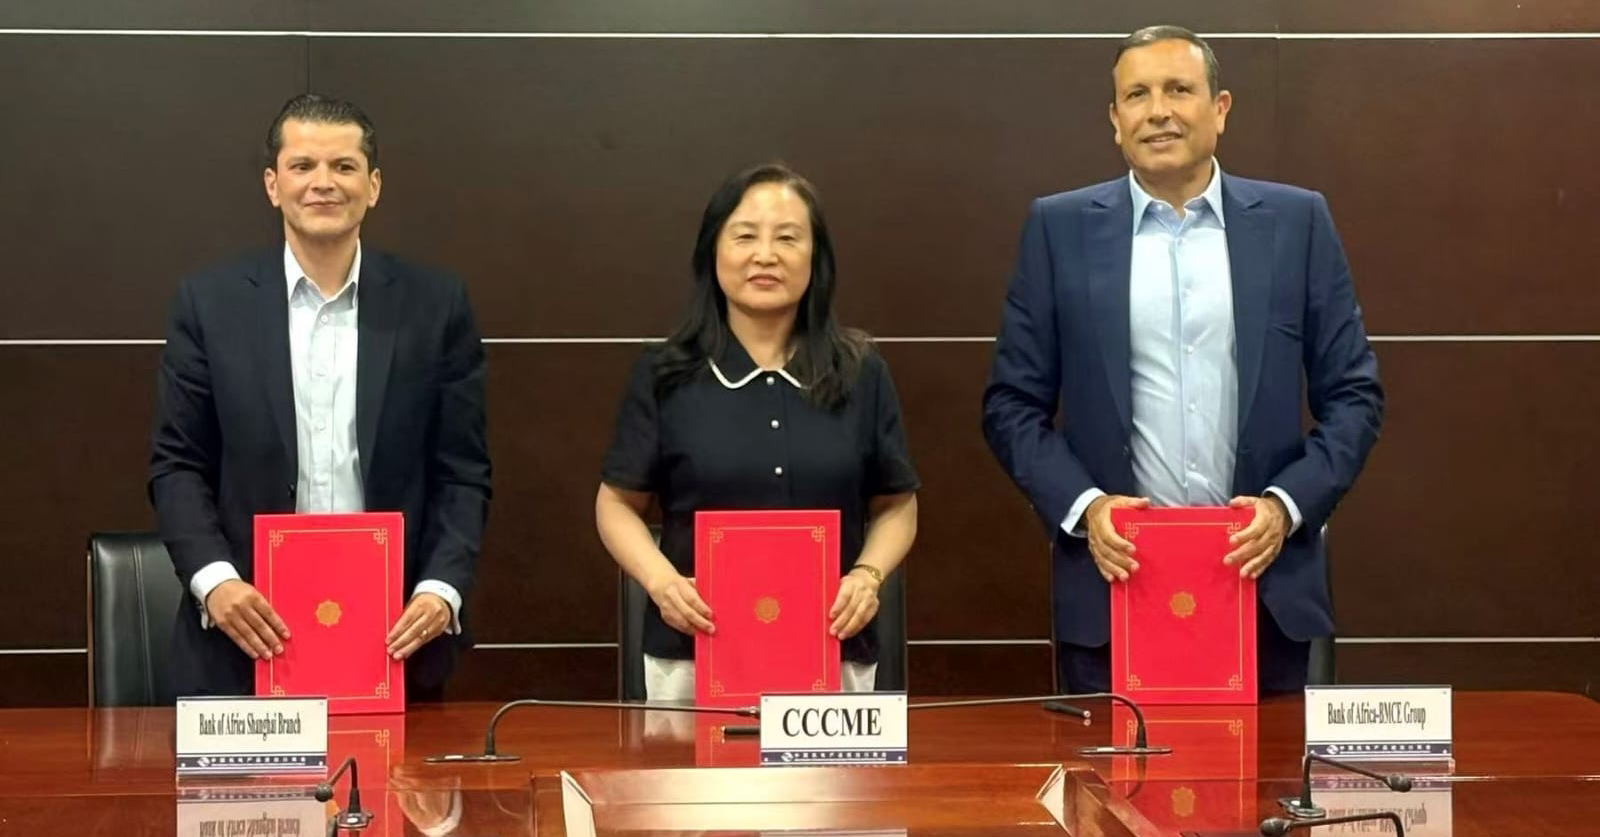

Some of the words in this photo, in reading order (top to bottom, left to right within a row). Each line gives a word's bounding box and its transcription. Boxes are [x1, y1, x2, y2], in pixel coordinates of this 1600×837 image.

[199, 713, 215, 735] Bank
[217, 713, 225, 735] of
[227, 713, 245, 735] Africa
[247, 713, 277, 741] Shanghai
[278, 713, 301, 734] Branch
[782, 708, 881, 737] CCCME
[1328, 703, 1345, 724] Bank
[1347, 702, 1354, 724] of
[1403, 702, 1426, 729] Group
